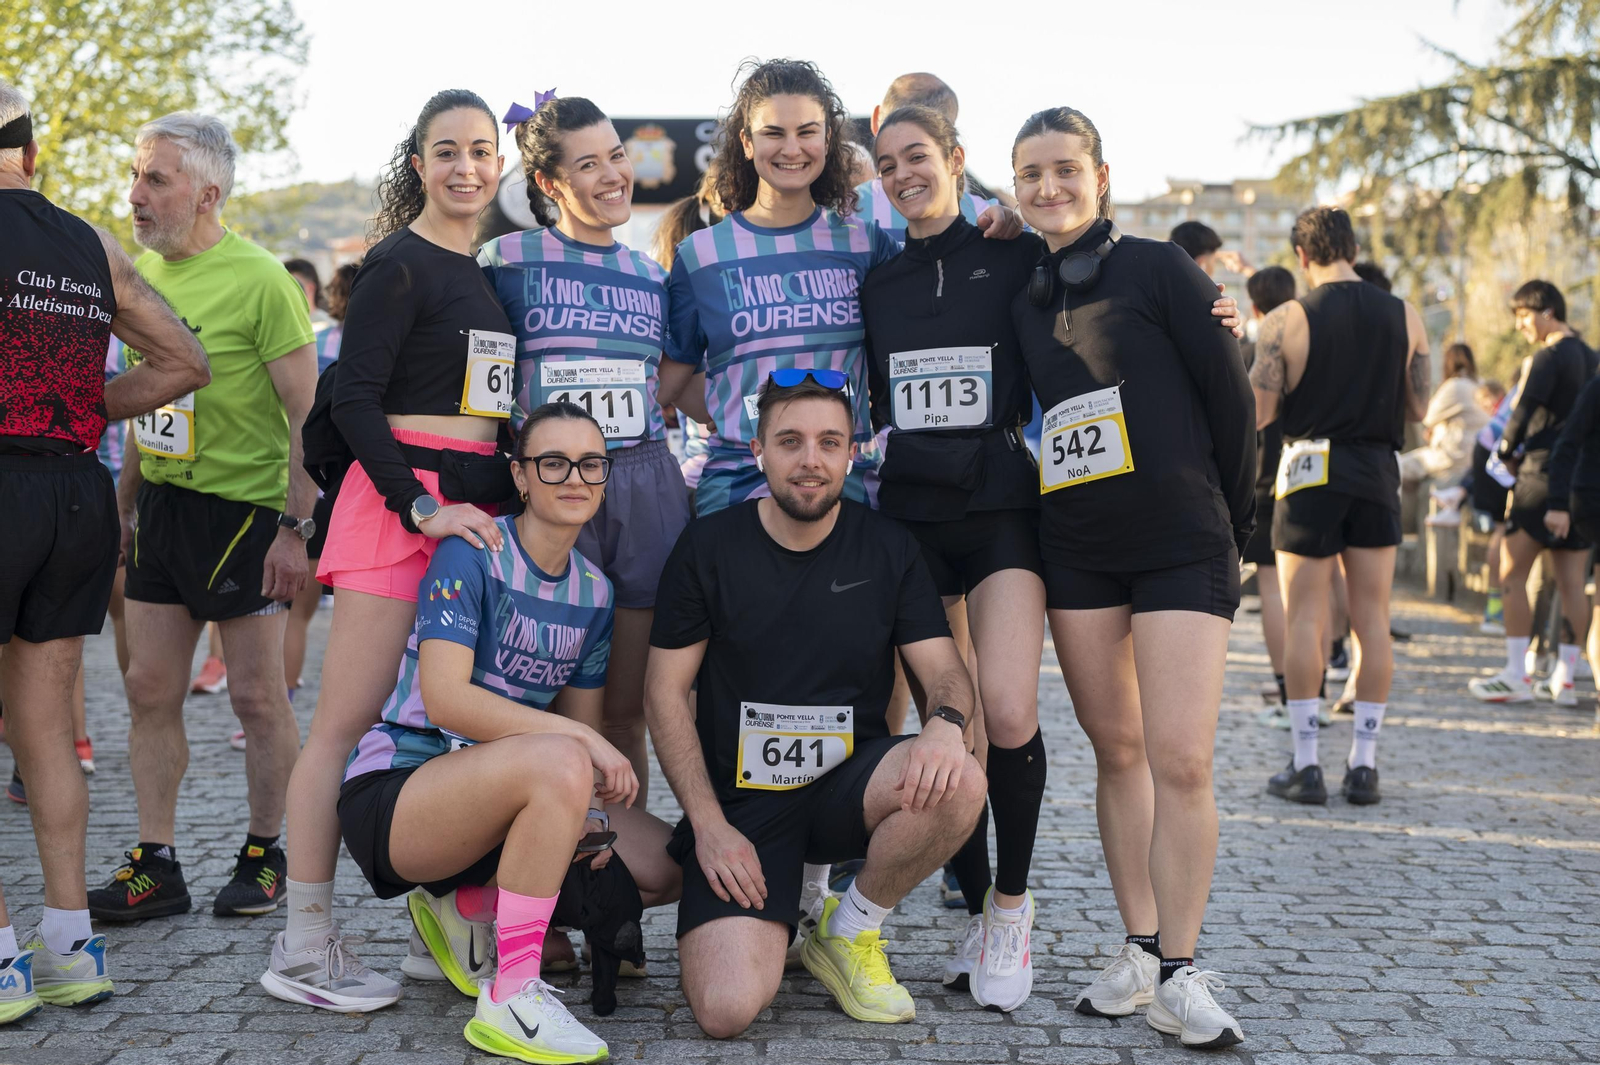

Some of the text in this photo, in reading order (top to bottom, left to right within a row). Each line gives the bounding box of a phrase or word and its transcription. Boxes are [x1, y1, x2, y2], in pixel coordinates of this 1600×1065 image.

[17, 269, 102, 299] Club Escola
[7, 293, 85, 317] Atletismo
[524, 307, 662, 341] OURENSE
[731, 300, 861, 337] OURENSE
[546, 376, 577, 384] OURENSE
[893, 366, 918, 375] OURENSE
[901, 377, 979, 410] 1113
[924, 413, 949, 426] Pipa
[1070, 404, 1085, 412] VELLA
[137, 411, 175, 438] 412
[1052, 425, 1106, 466] 542
[1067, 464, 1091, 479] NoA
[514, 614, 589, 660] NOCTURN
[745, 720, 774, 728] OURENSE
[762, 737, 824, 768] 641
[772, 774, 814, 785] Martín
